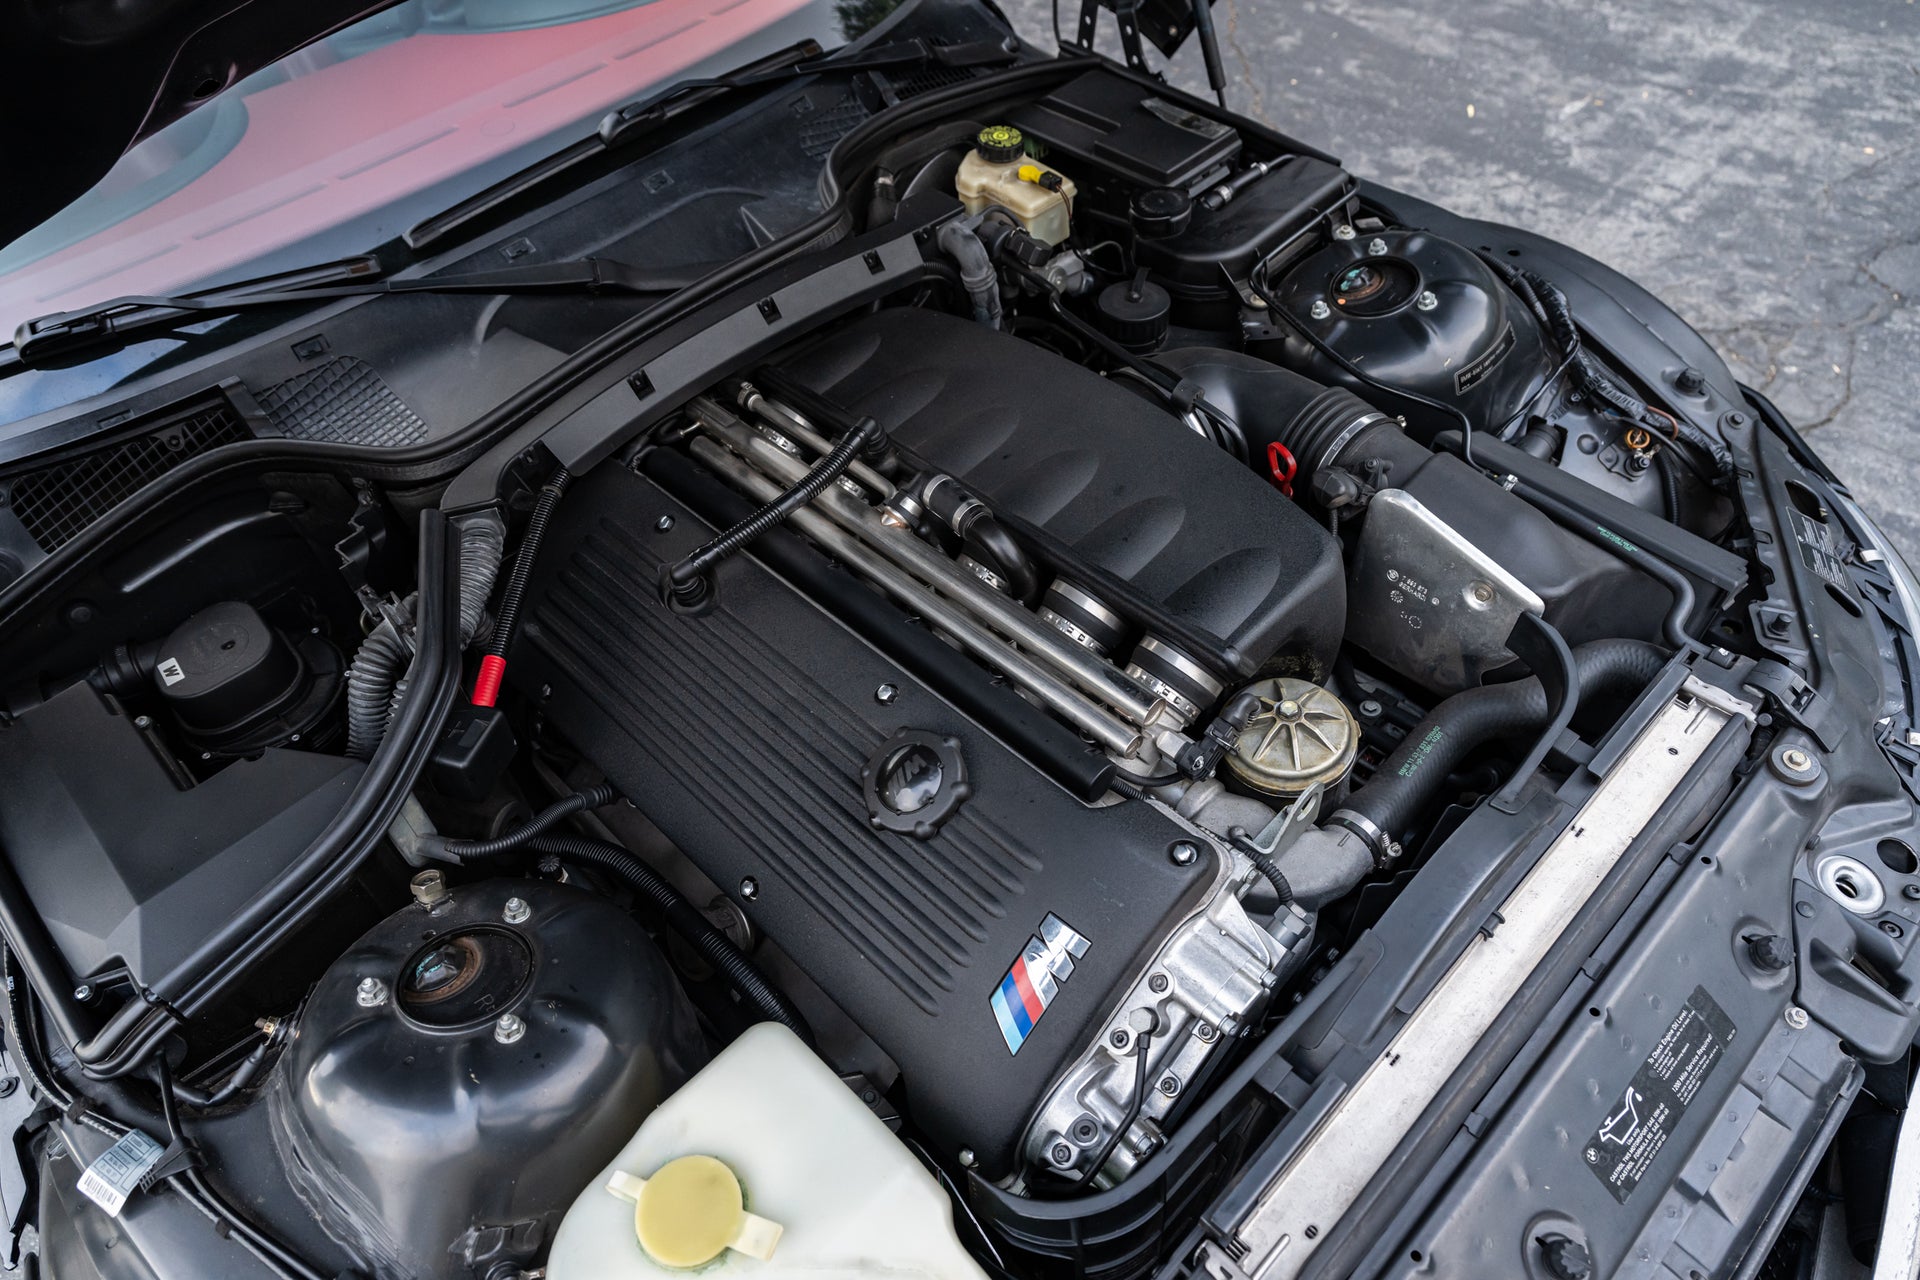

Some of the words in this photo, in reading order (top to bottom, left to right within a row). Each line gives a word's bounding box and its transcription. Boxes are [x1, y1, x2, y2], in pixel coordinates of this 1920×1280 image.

[1648, 1056, 1654, 1065] To
[1652, 1043, 1664, 1059] Check
[1661, 1028, 1675, 1046] Engine
[1679, 1070, 1688, 1082] Mile
[1685, 1054, 1699, 1072] Service
[1610, 1161, 1625, 1182] CASTROL
[1623, 1151, 1631, 1163] TWS
[1629, 1125, 1649, 1154] MOTORSPORT
[1647, 1116, 1655, 1127] SAE
[1619, 1160, 1634, 1181] CASTROL
[1634, 1138, 1649, 1160] FORMULA
